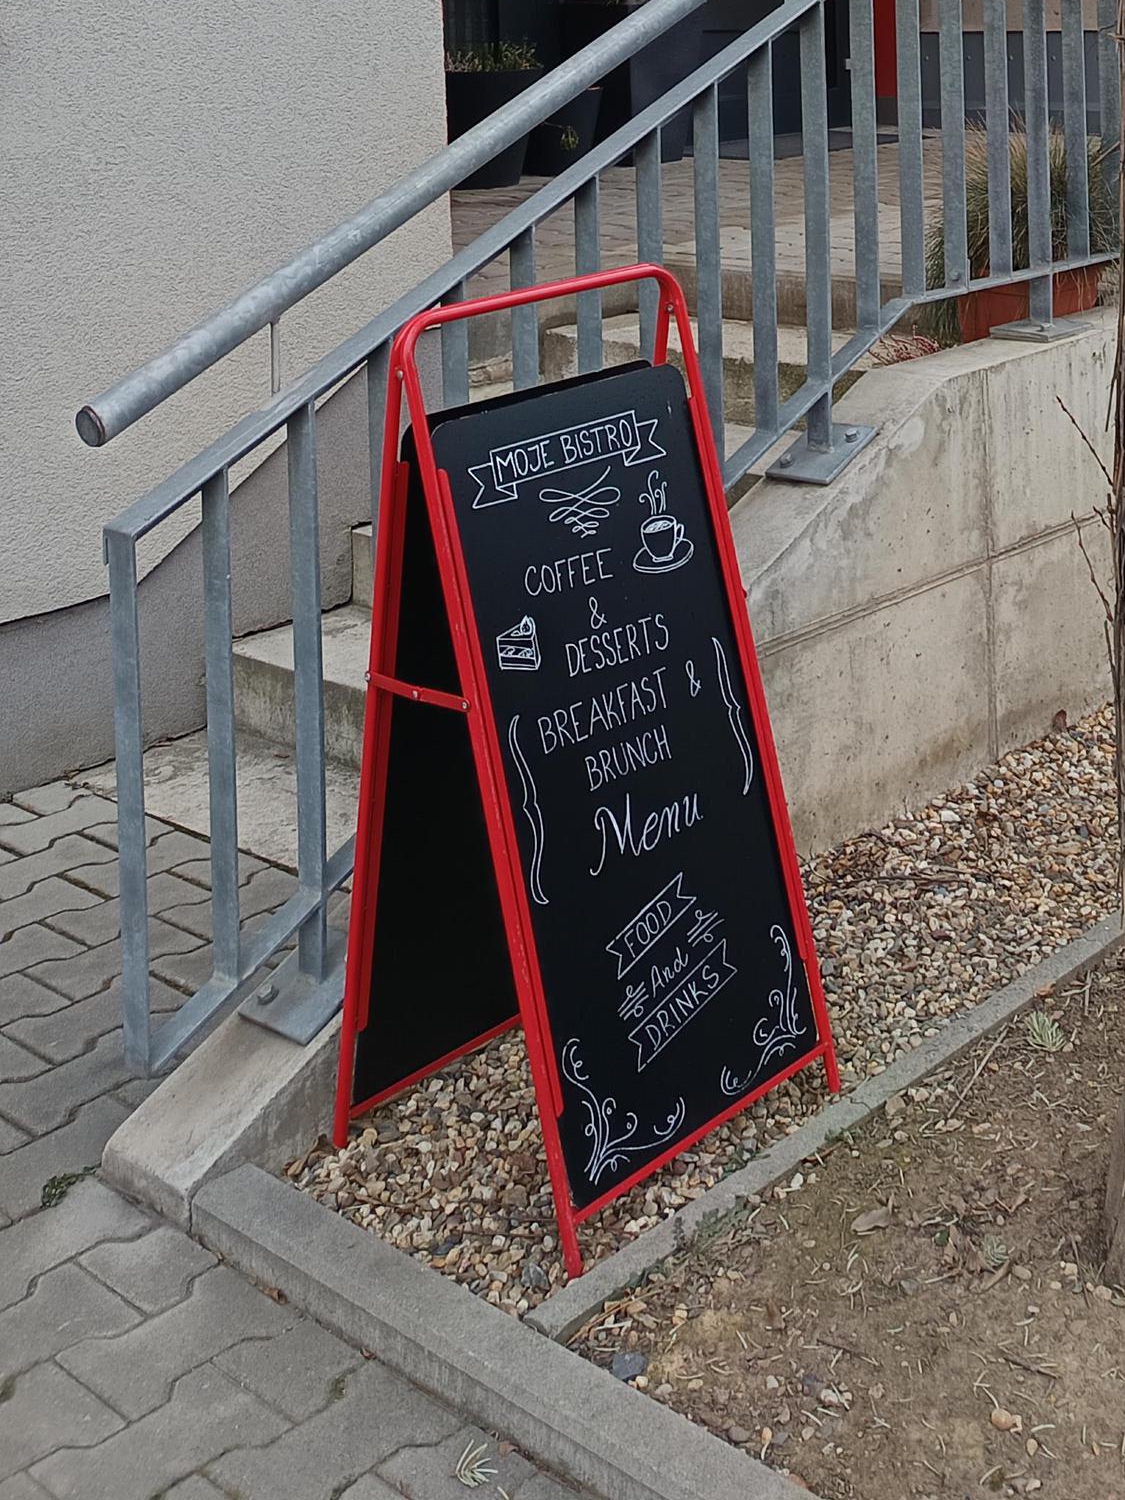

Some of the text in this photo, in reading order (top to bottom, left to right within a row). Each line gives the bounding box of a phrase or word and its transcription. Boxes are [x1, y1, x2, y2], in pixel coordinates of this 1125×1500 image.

[496, 419, 633, 482] MOJE BISTRO
[524, 548, 613, 596] COFFEE
[589, 597, 607, 628] &
[566, 614, 669, 677] DESSERTS
[537, 660, 701, 755] BREAKFAST &
[584, 724, 672, 792] BRUNCH
[590, 792, 703, 876] Menu
[623, 901, 673, 958] FOOD
[650, 947, 689, 999] And
[644, 965, 721, 1051] DRINKS
